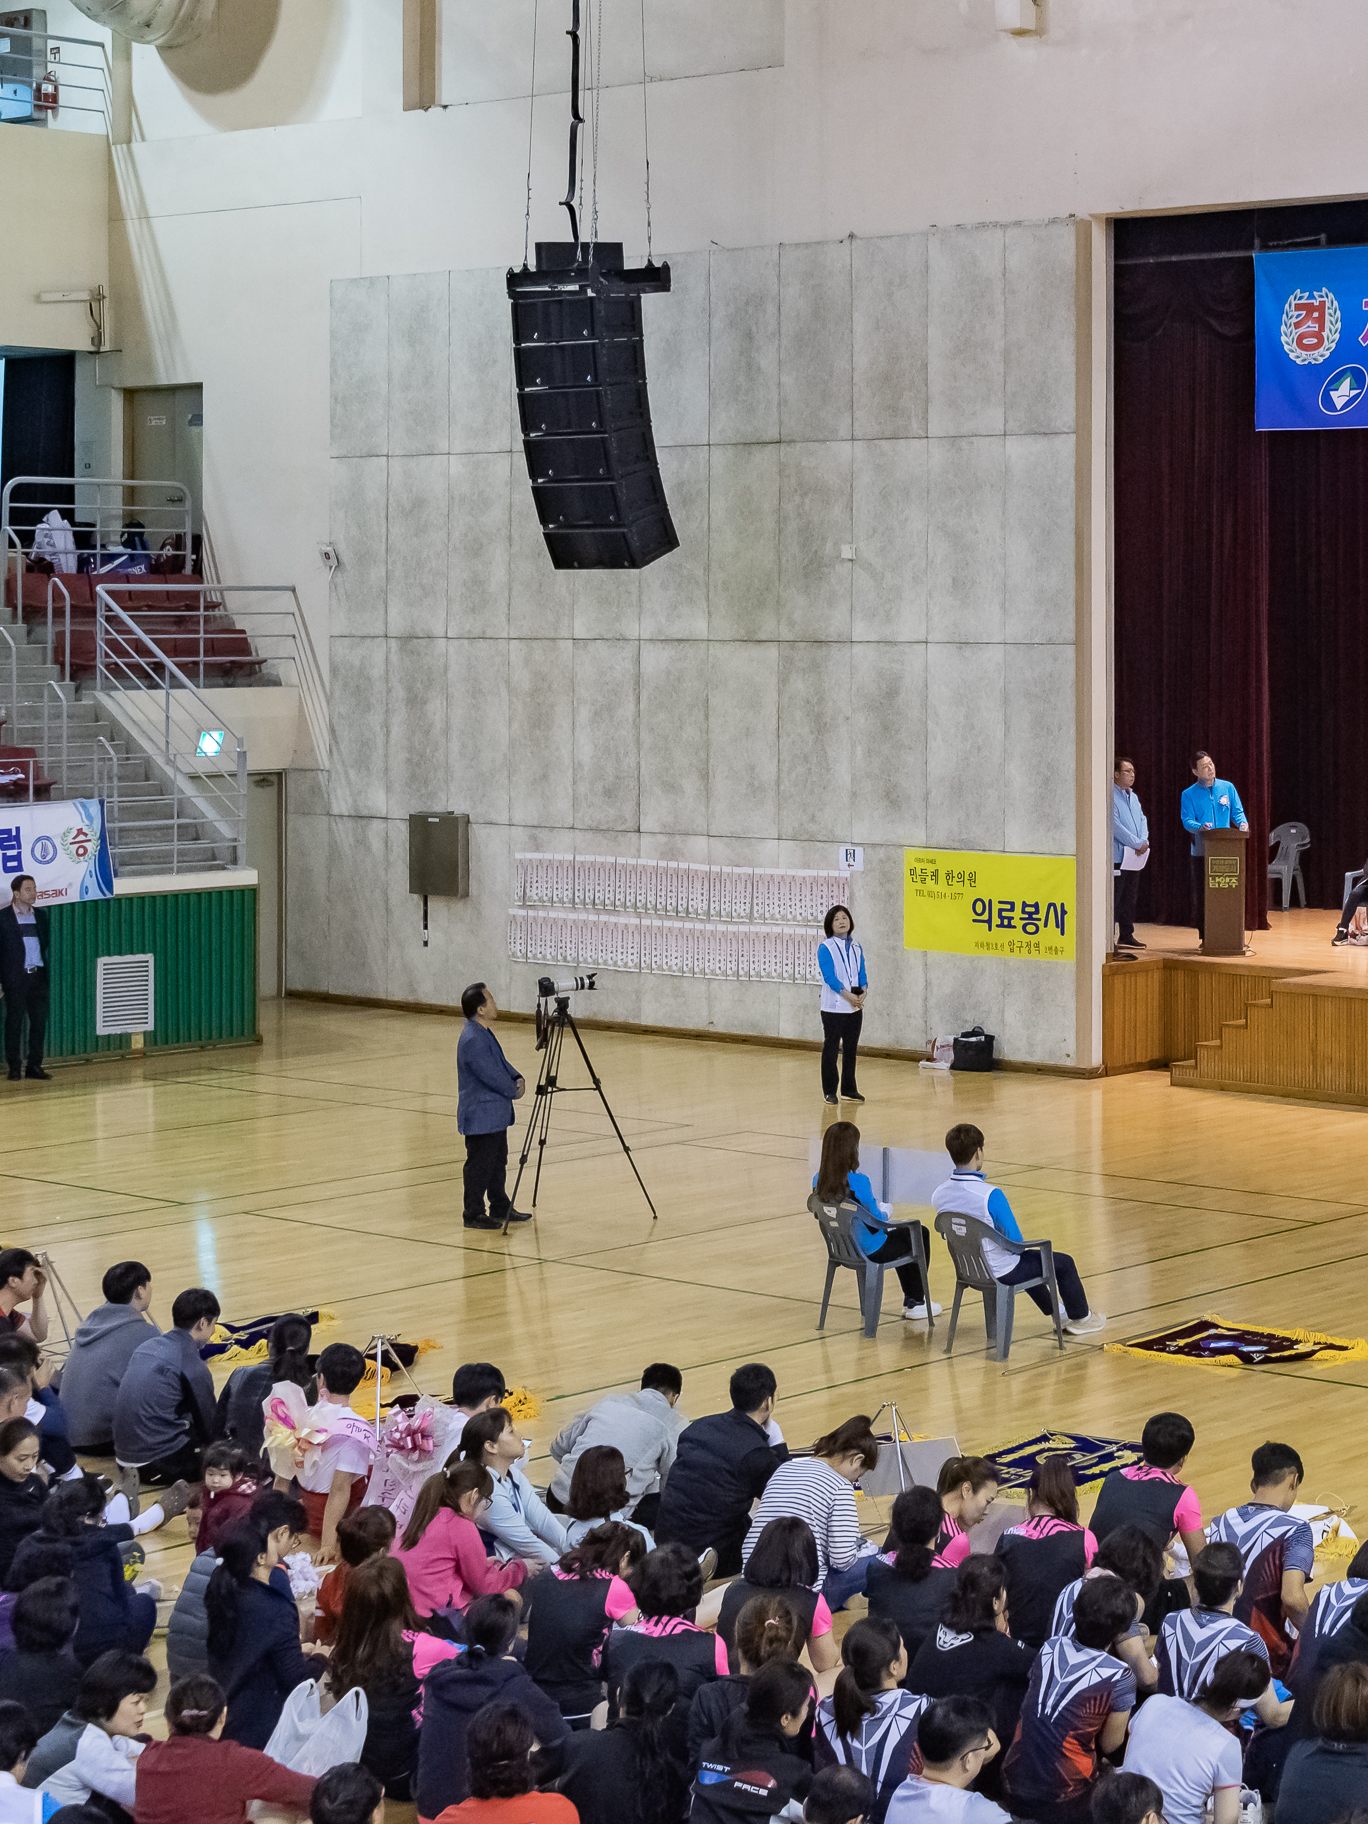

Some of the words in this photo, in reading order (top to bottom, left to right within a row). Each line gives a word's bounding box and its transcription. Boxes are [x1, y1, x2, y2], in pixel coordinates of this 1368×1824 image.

[1293, 299, 1326, 354] 경
[69, 827, 92, 858] 승
[909, 866, 939, 886] 민들레
[944, 869, 977, 888] 한의원
[1209, 876, 1239, 889] 남양주
[971, 897, 1068, 937] 의료봉사
[1007, 939, 1041, 955] 압구정역
[702, 1761, 731, 1773] TWIST
[733, 1781, 769, 1797] PACE
